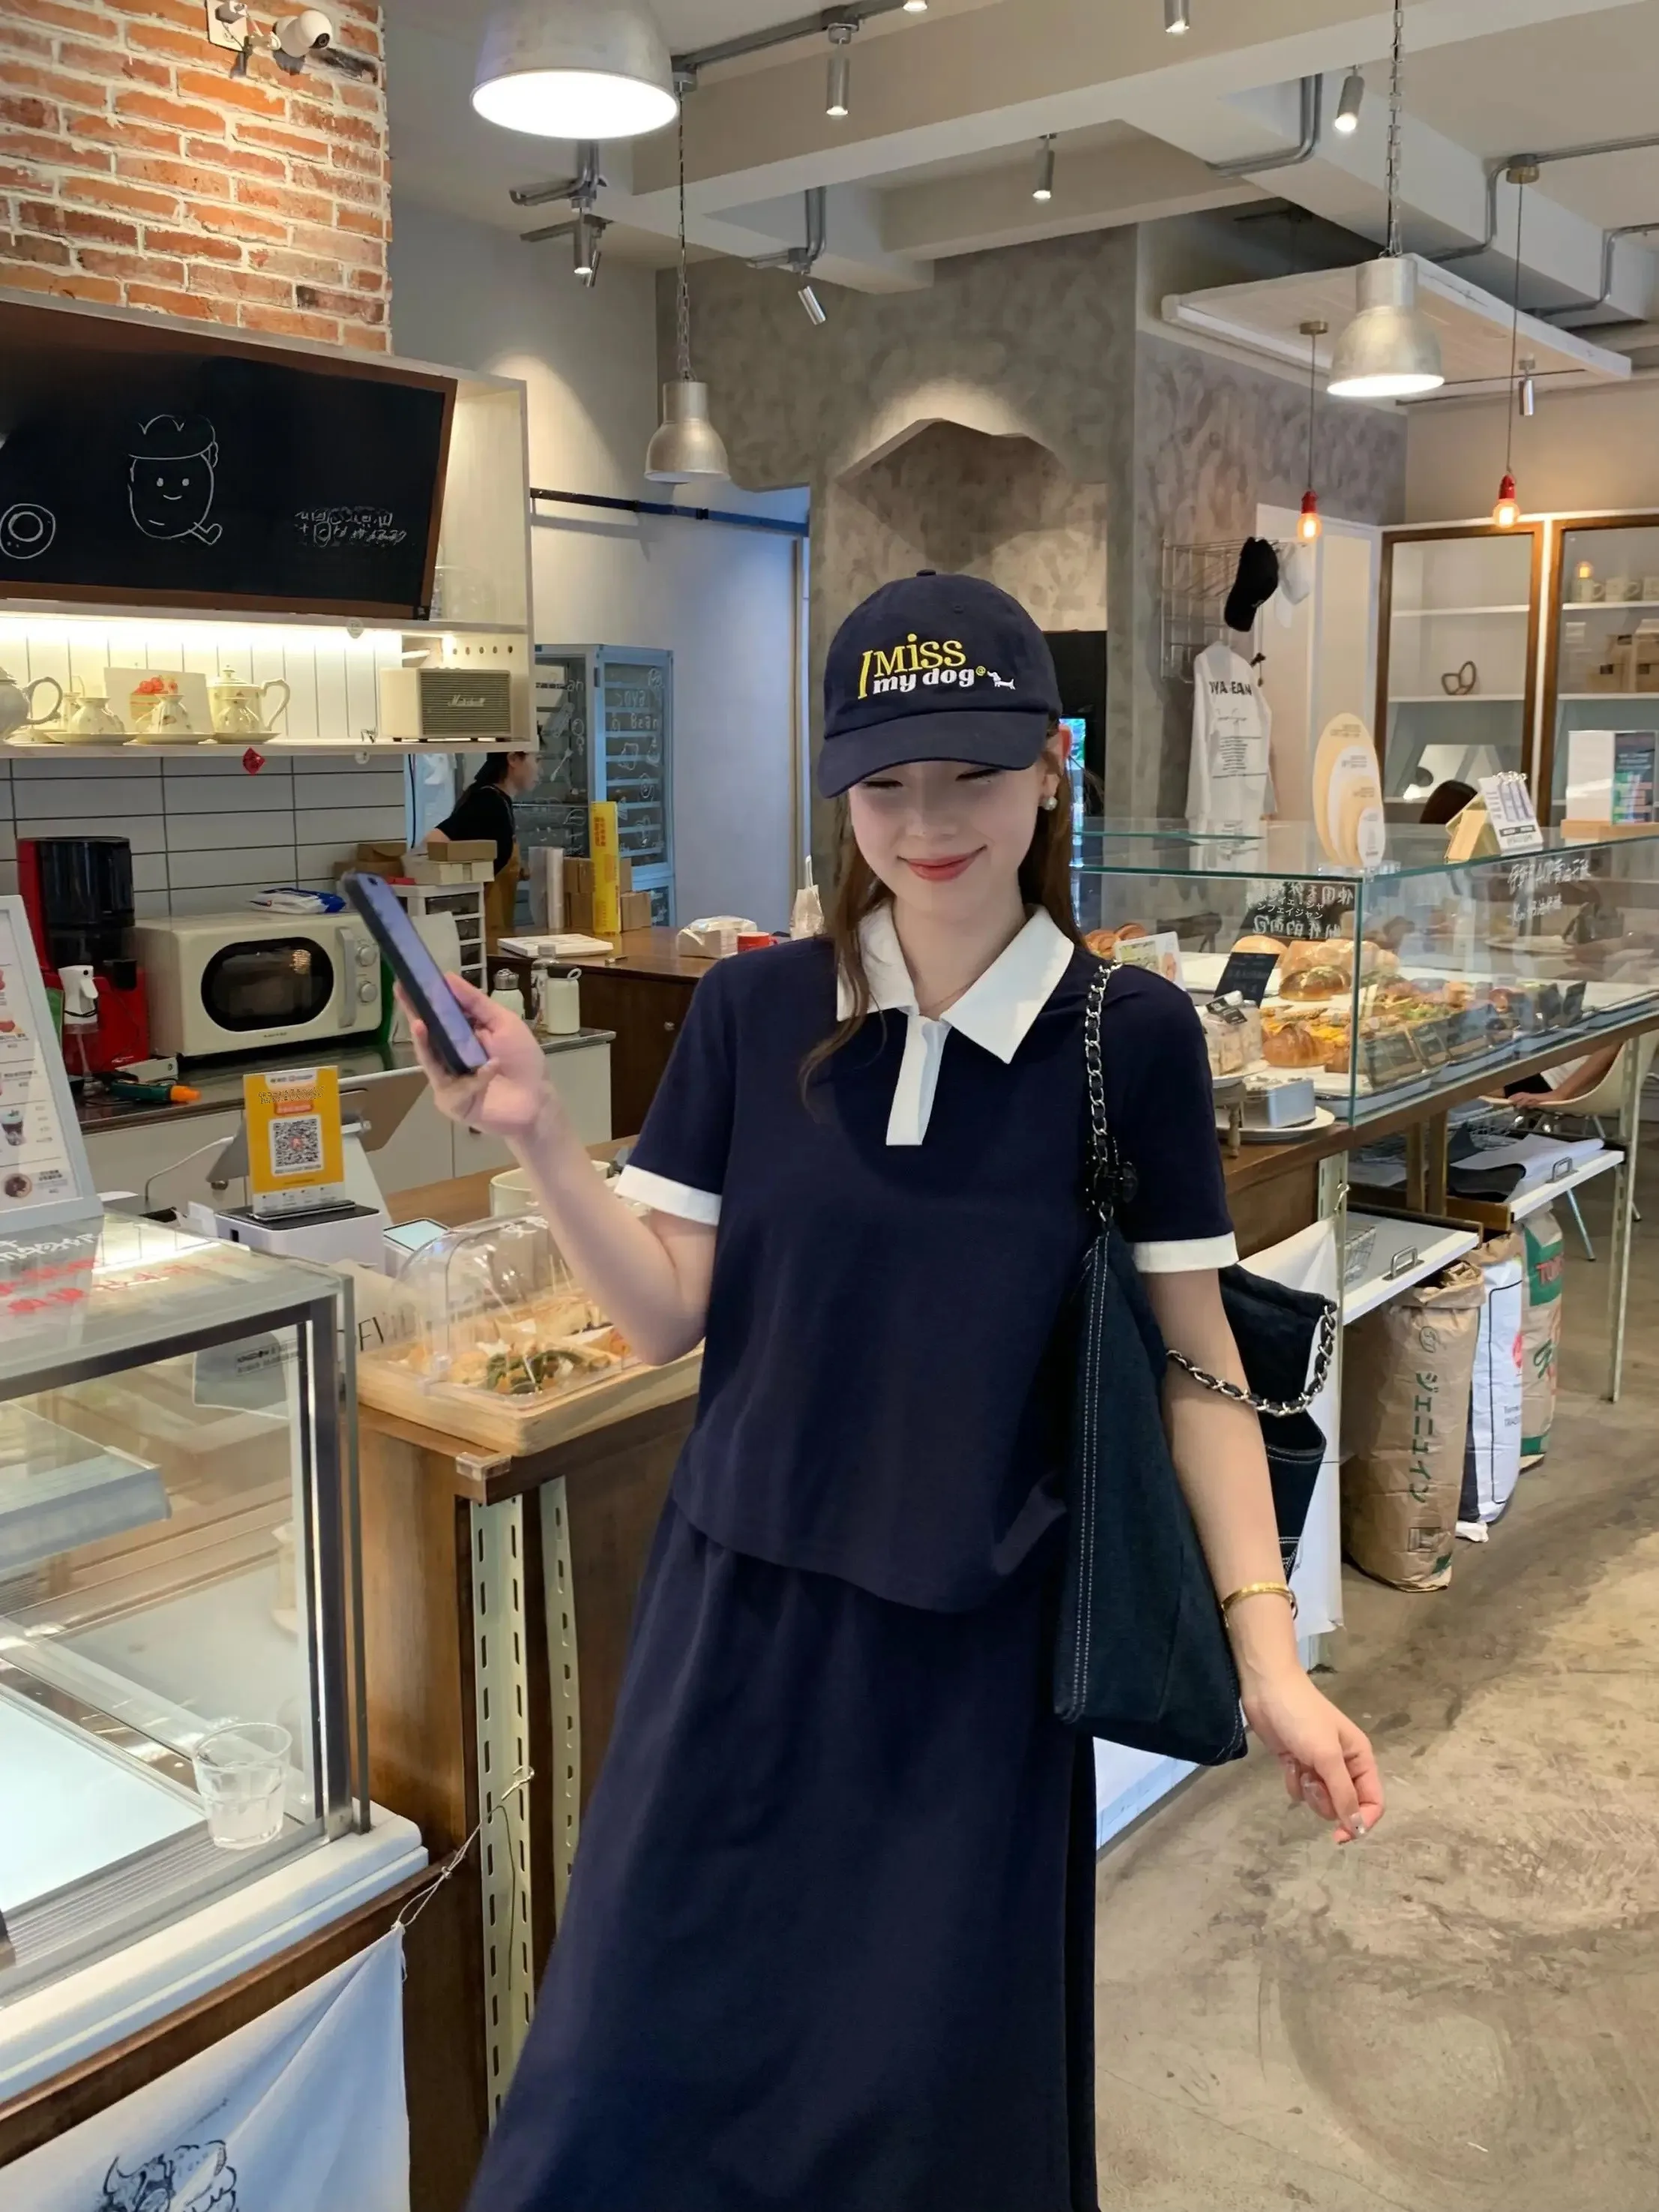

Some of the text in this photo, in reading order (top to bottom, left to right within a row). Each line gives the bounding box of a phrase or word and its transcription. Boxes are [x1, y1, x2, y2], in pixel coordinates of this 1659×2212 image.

[858, 649, 873, 700] I
[872, 667, 975, 694] my dog
